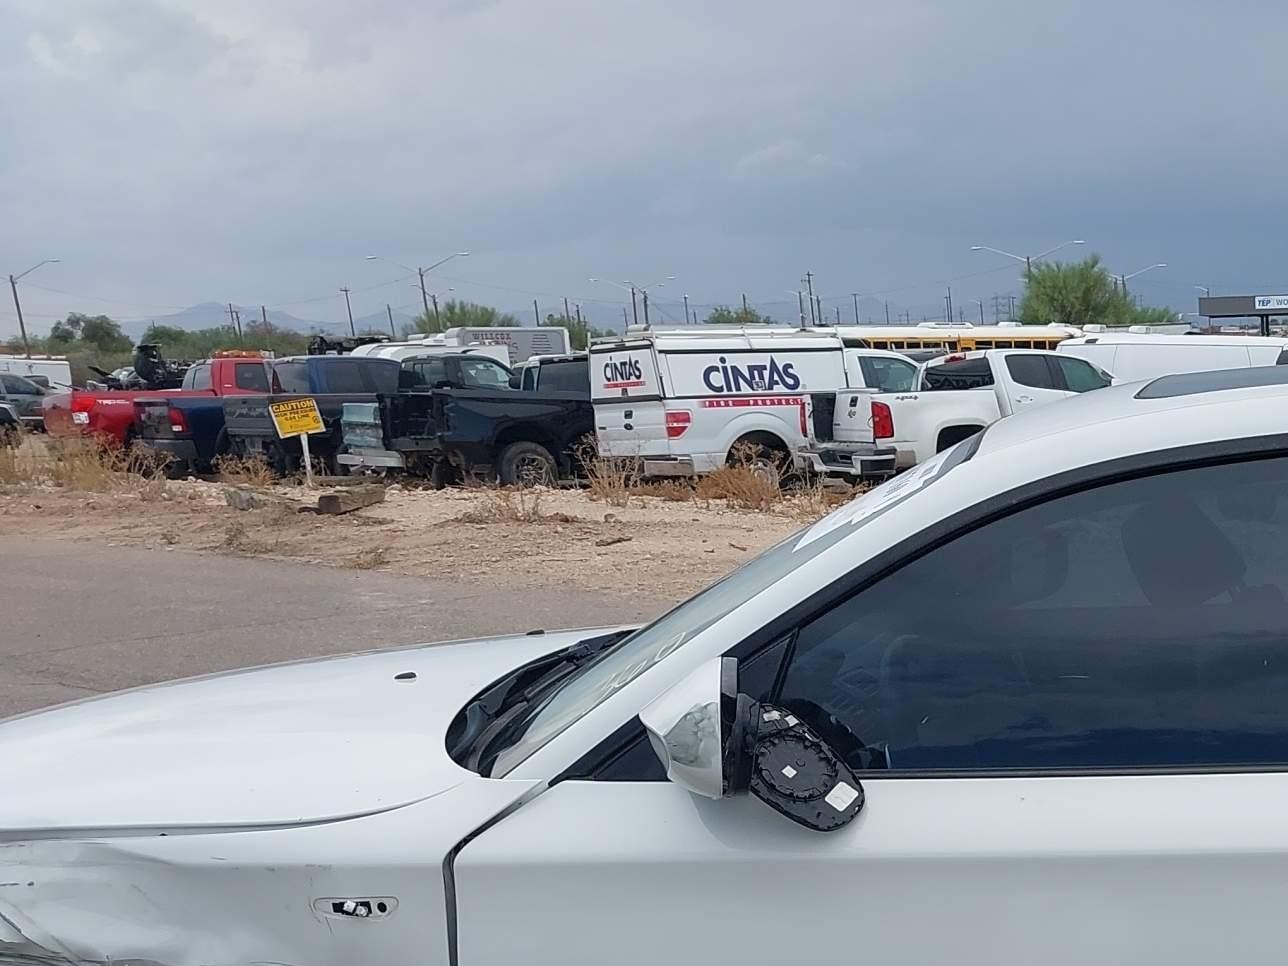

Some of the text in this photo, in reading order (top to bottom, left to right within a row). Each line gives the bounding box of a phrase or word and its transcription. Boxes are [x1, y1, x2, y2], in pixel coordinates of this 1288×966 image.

[1257, 299, 1271, 307] TEP
[603, 352, 642, 382] CINTAS
[702, 354, 801, 393] CINTAS
[272, 400, 314, 412] CAUTION
